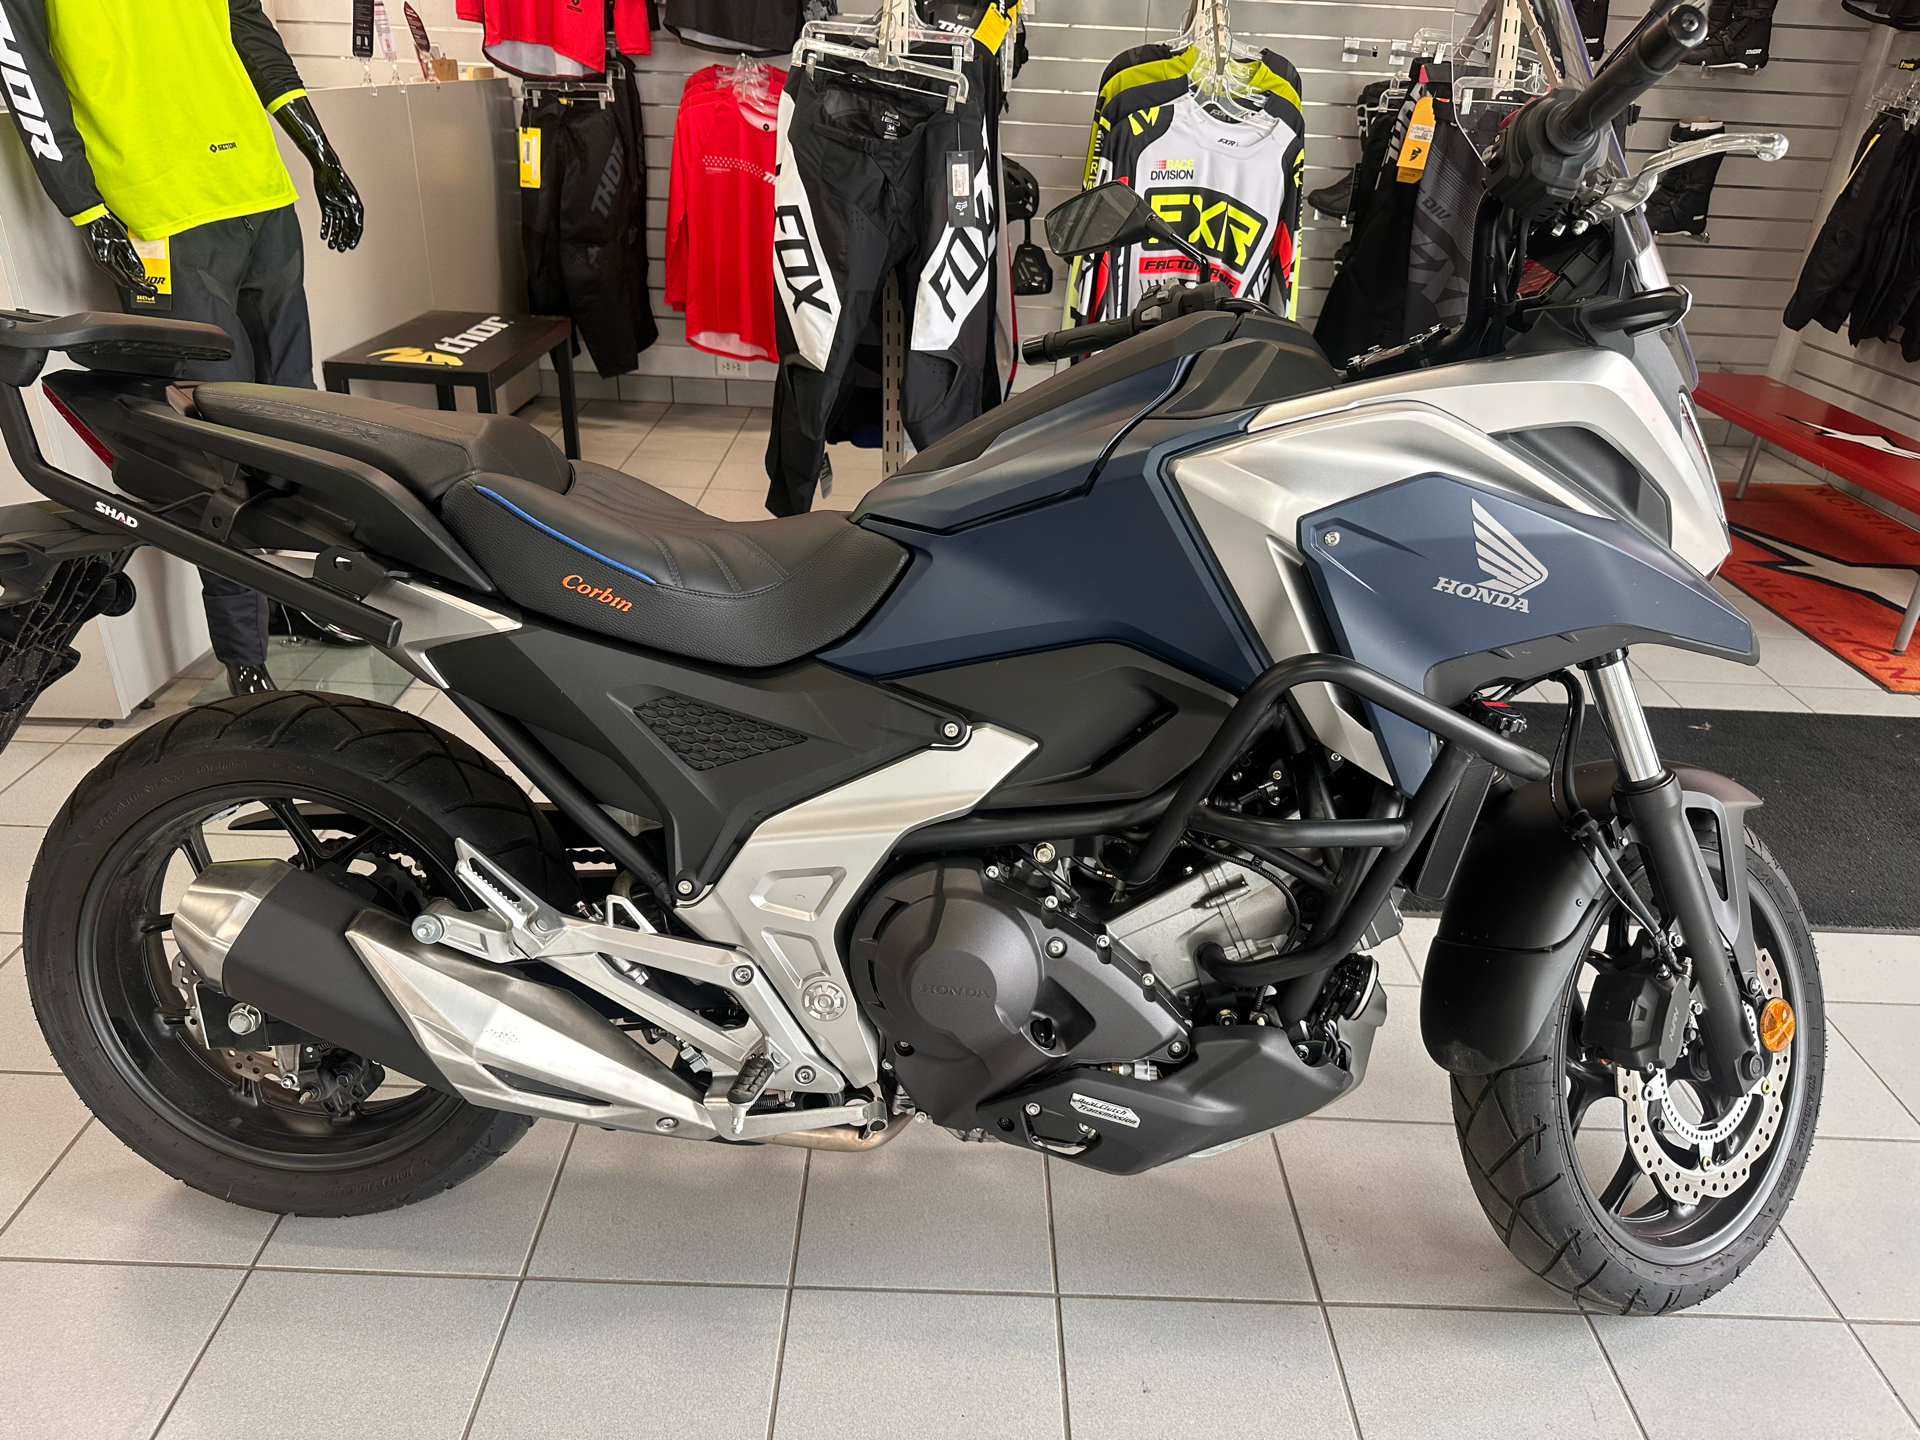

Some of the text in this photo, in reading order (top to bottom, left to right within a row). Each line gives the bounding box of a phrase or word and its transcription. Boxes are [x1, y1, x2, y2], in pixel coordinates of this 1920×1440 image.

[938, 20, 975, 37] THO
[0, 0, 63, 162] HOR
[1150, 170, 1194, 180] DIVISION
[1166, 159, 1195, 170] RACE
[1148, 194, 1262, 267] FXR
[774, 205, 833, 316] FOX
[95, 501, 139, 529] SHAD
[562, 574, 633, 612] Corbin
[1432, 576, 1530, 614] HONDA
[920, 984, 990, 999] HONDA
[1078, 1104, 1138, 1125] Transmission
[1099, 1103, 1127, 1116] Clutch
